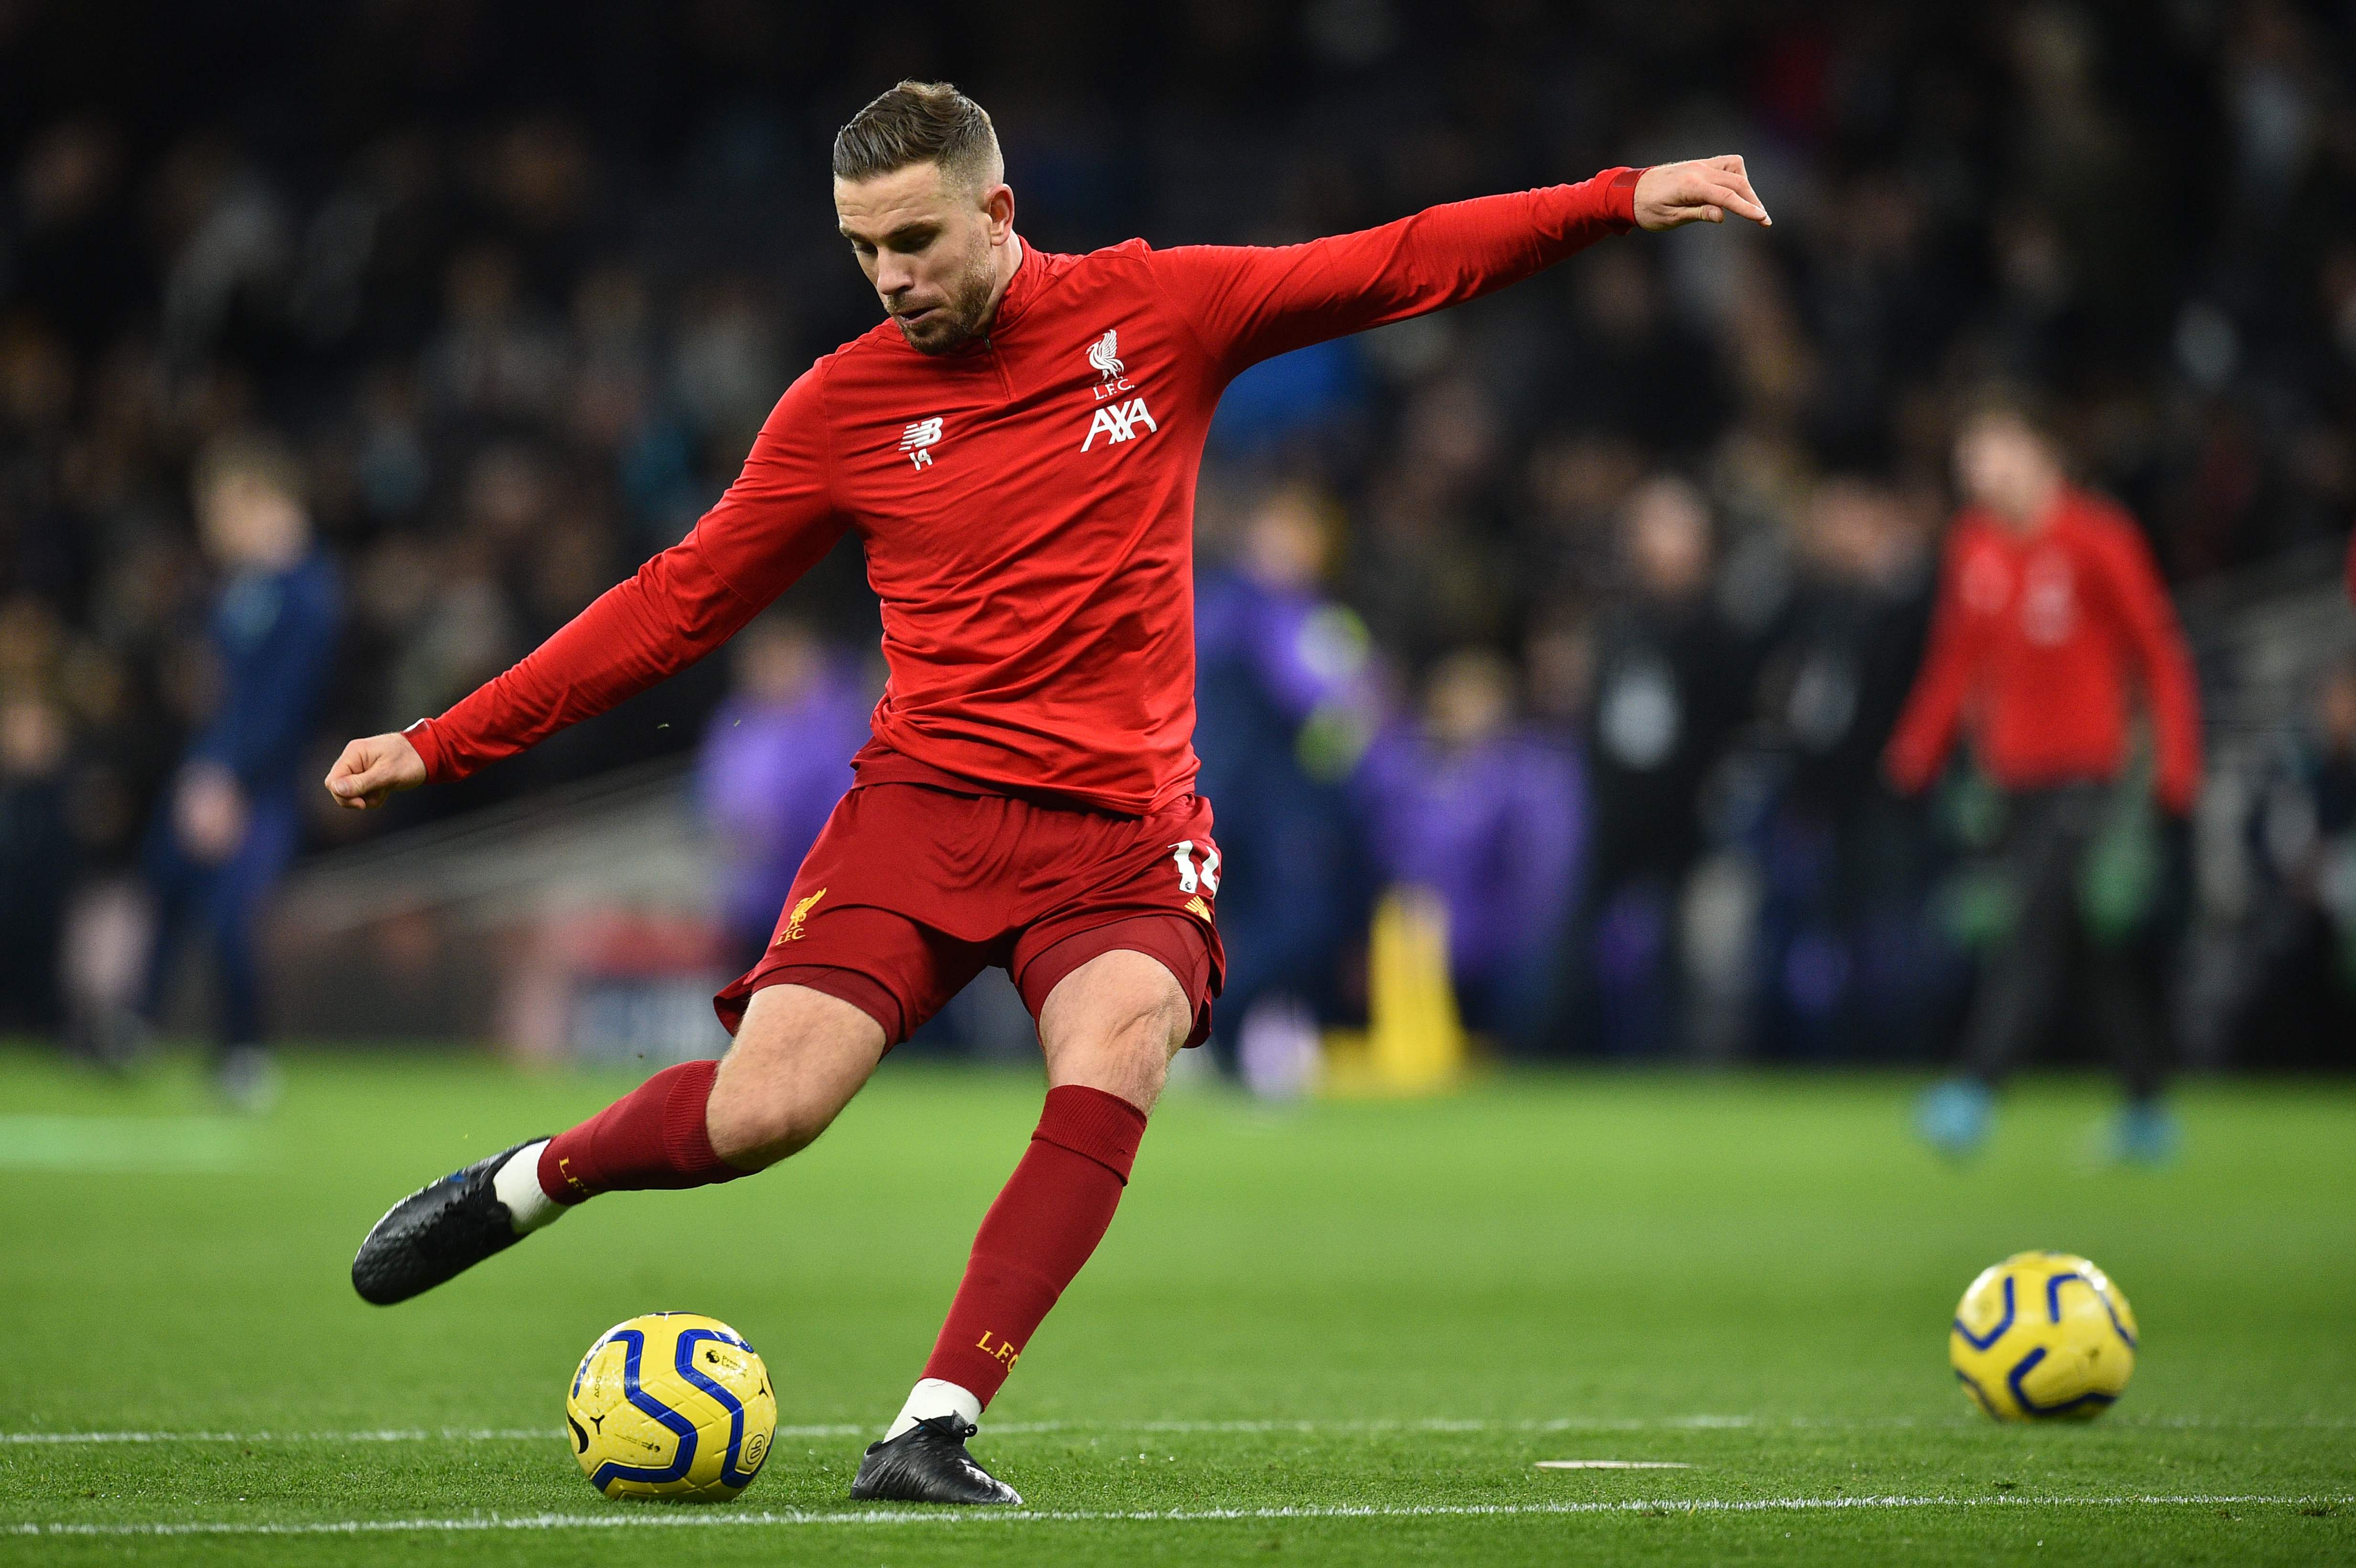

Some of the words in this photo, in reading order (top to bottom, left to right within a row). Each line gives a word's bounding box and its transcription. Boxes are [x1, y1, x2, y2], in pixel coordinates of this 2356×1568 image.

[1093, 379, 1135, 400] L.F.C.
[1080, 398, 1157, 453] AXA
[909, 448, 933, 471] 14
